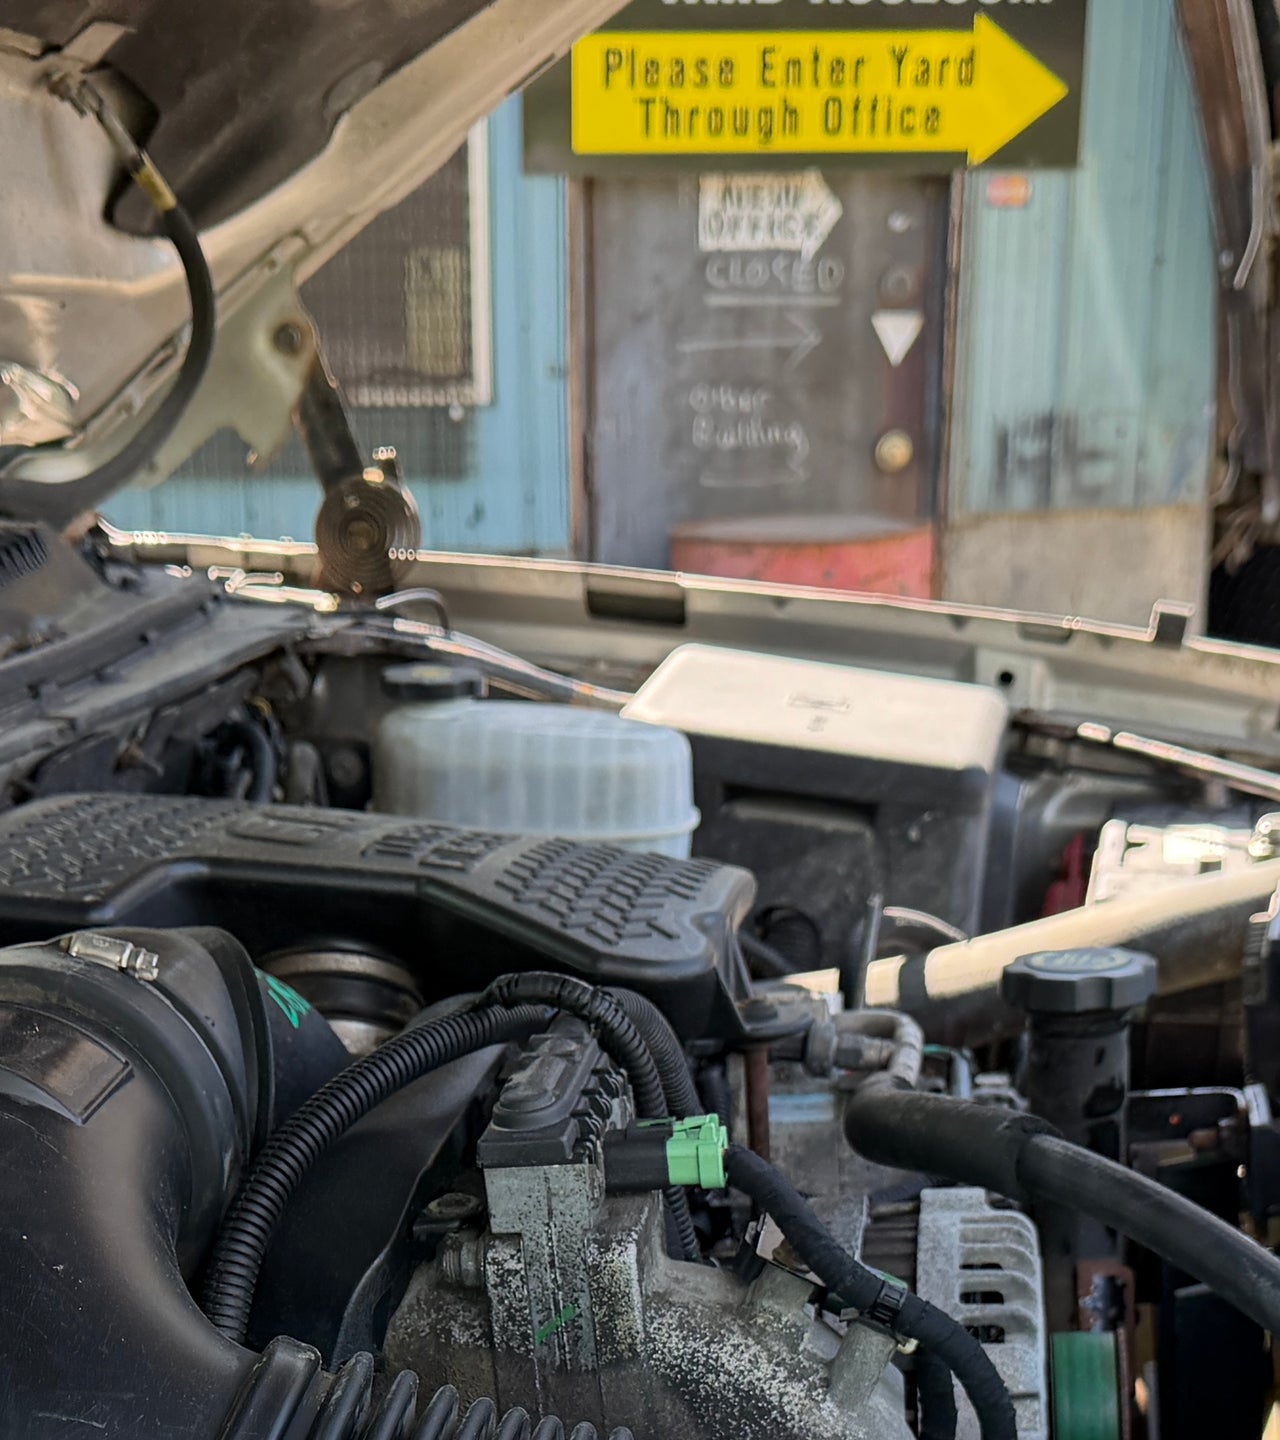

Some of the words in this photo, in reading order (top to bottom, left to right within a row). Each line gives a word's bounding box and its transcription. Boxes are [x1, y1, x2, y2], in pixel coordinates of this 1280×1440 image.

[603, 46, 735, 90] Please
[761, 46, 866, 89] Enter
[890, 45, 977, 88] Yard
[639, 96, 801, 144] Through
[824, 95, 943, 136] Office
